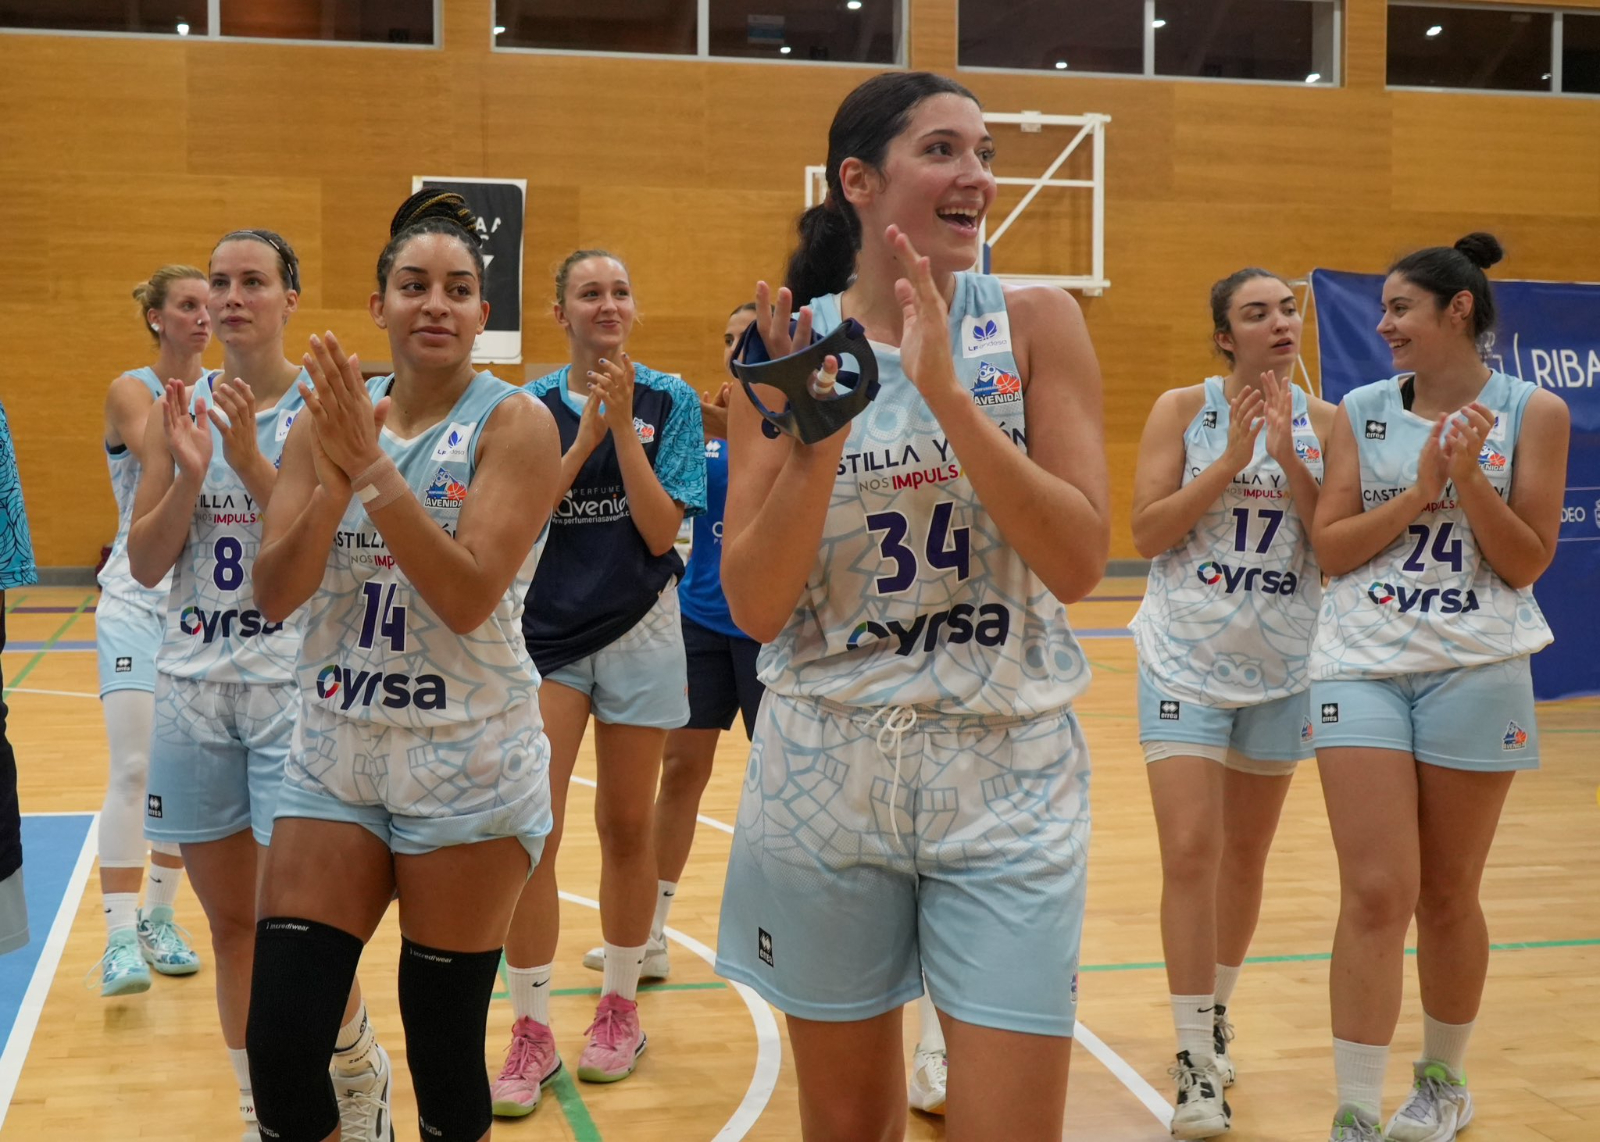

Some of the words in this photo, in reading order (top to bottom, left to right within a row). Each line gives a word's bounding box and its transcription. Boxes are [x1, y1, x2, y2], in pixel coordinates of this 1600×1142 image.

[974, 392, 1022, 406] AVENIDA
[836, 444, 921, 476] STILLA
[573, 484, 622, 496] PERFUME
[859, 477, 890, 493] NOS
[1270, 474, 1281, 488] Y
[864, 500, 971, 597] 34
[1232, 507, 1284, 555] 17
[1402, 521, 1463, 573] 24
[213, 535, 245, 593] 8
[358, 580, 407, 654] 14
